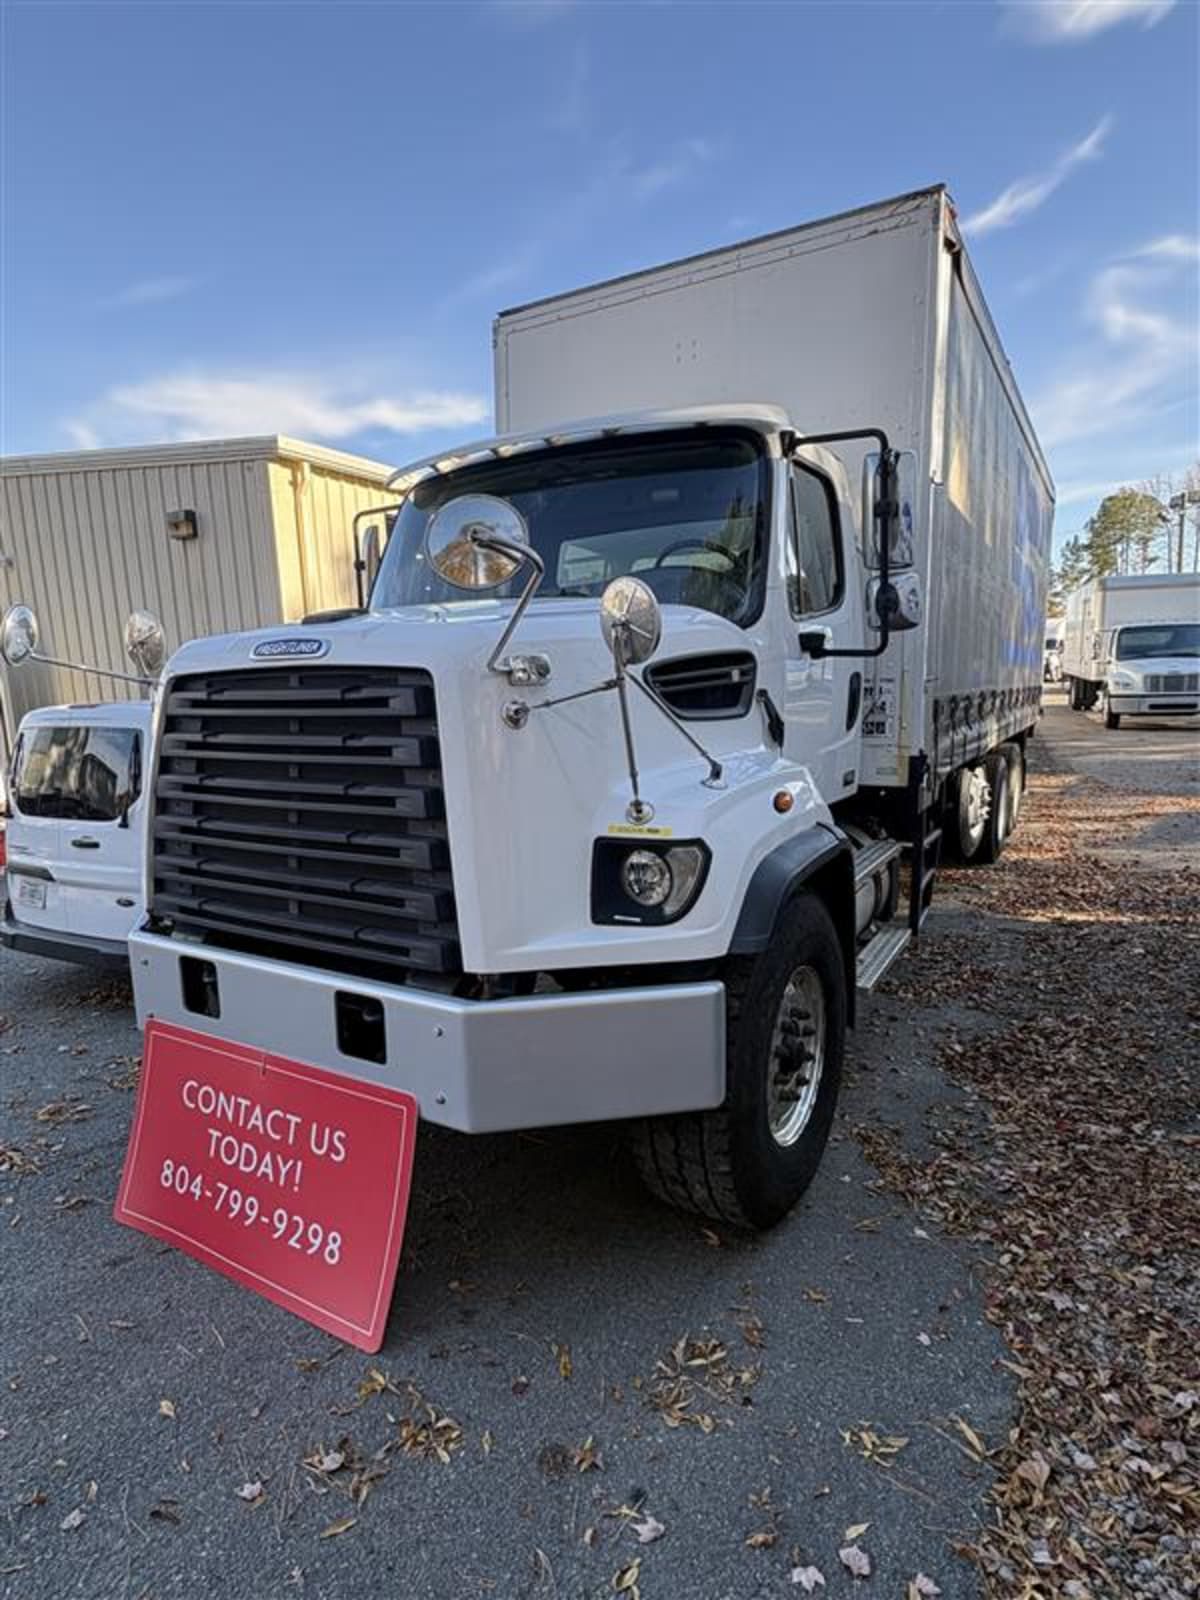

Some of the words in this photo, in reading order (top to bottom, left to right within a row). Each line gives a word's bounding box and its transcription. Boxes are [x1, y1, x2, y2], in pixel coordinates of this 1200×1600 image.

[182, 1079, 301, 1146] CONTACT
[310, 1122, 347, 1163] US
[208, 1128, 303, 1192] TODAY!
[160, 1159, 342, 1266] 804-799-9298
